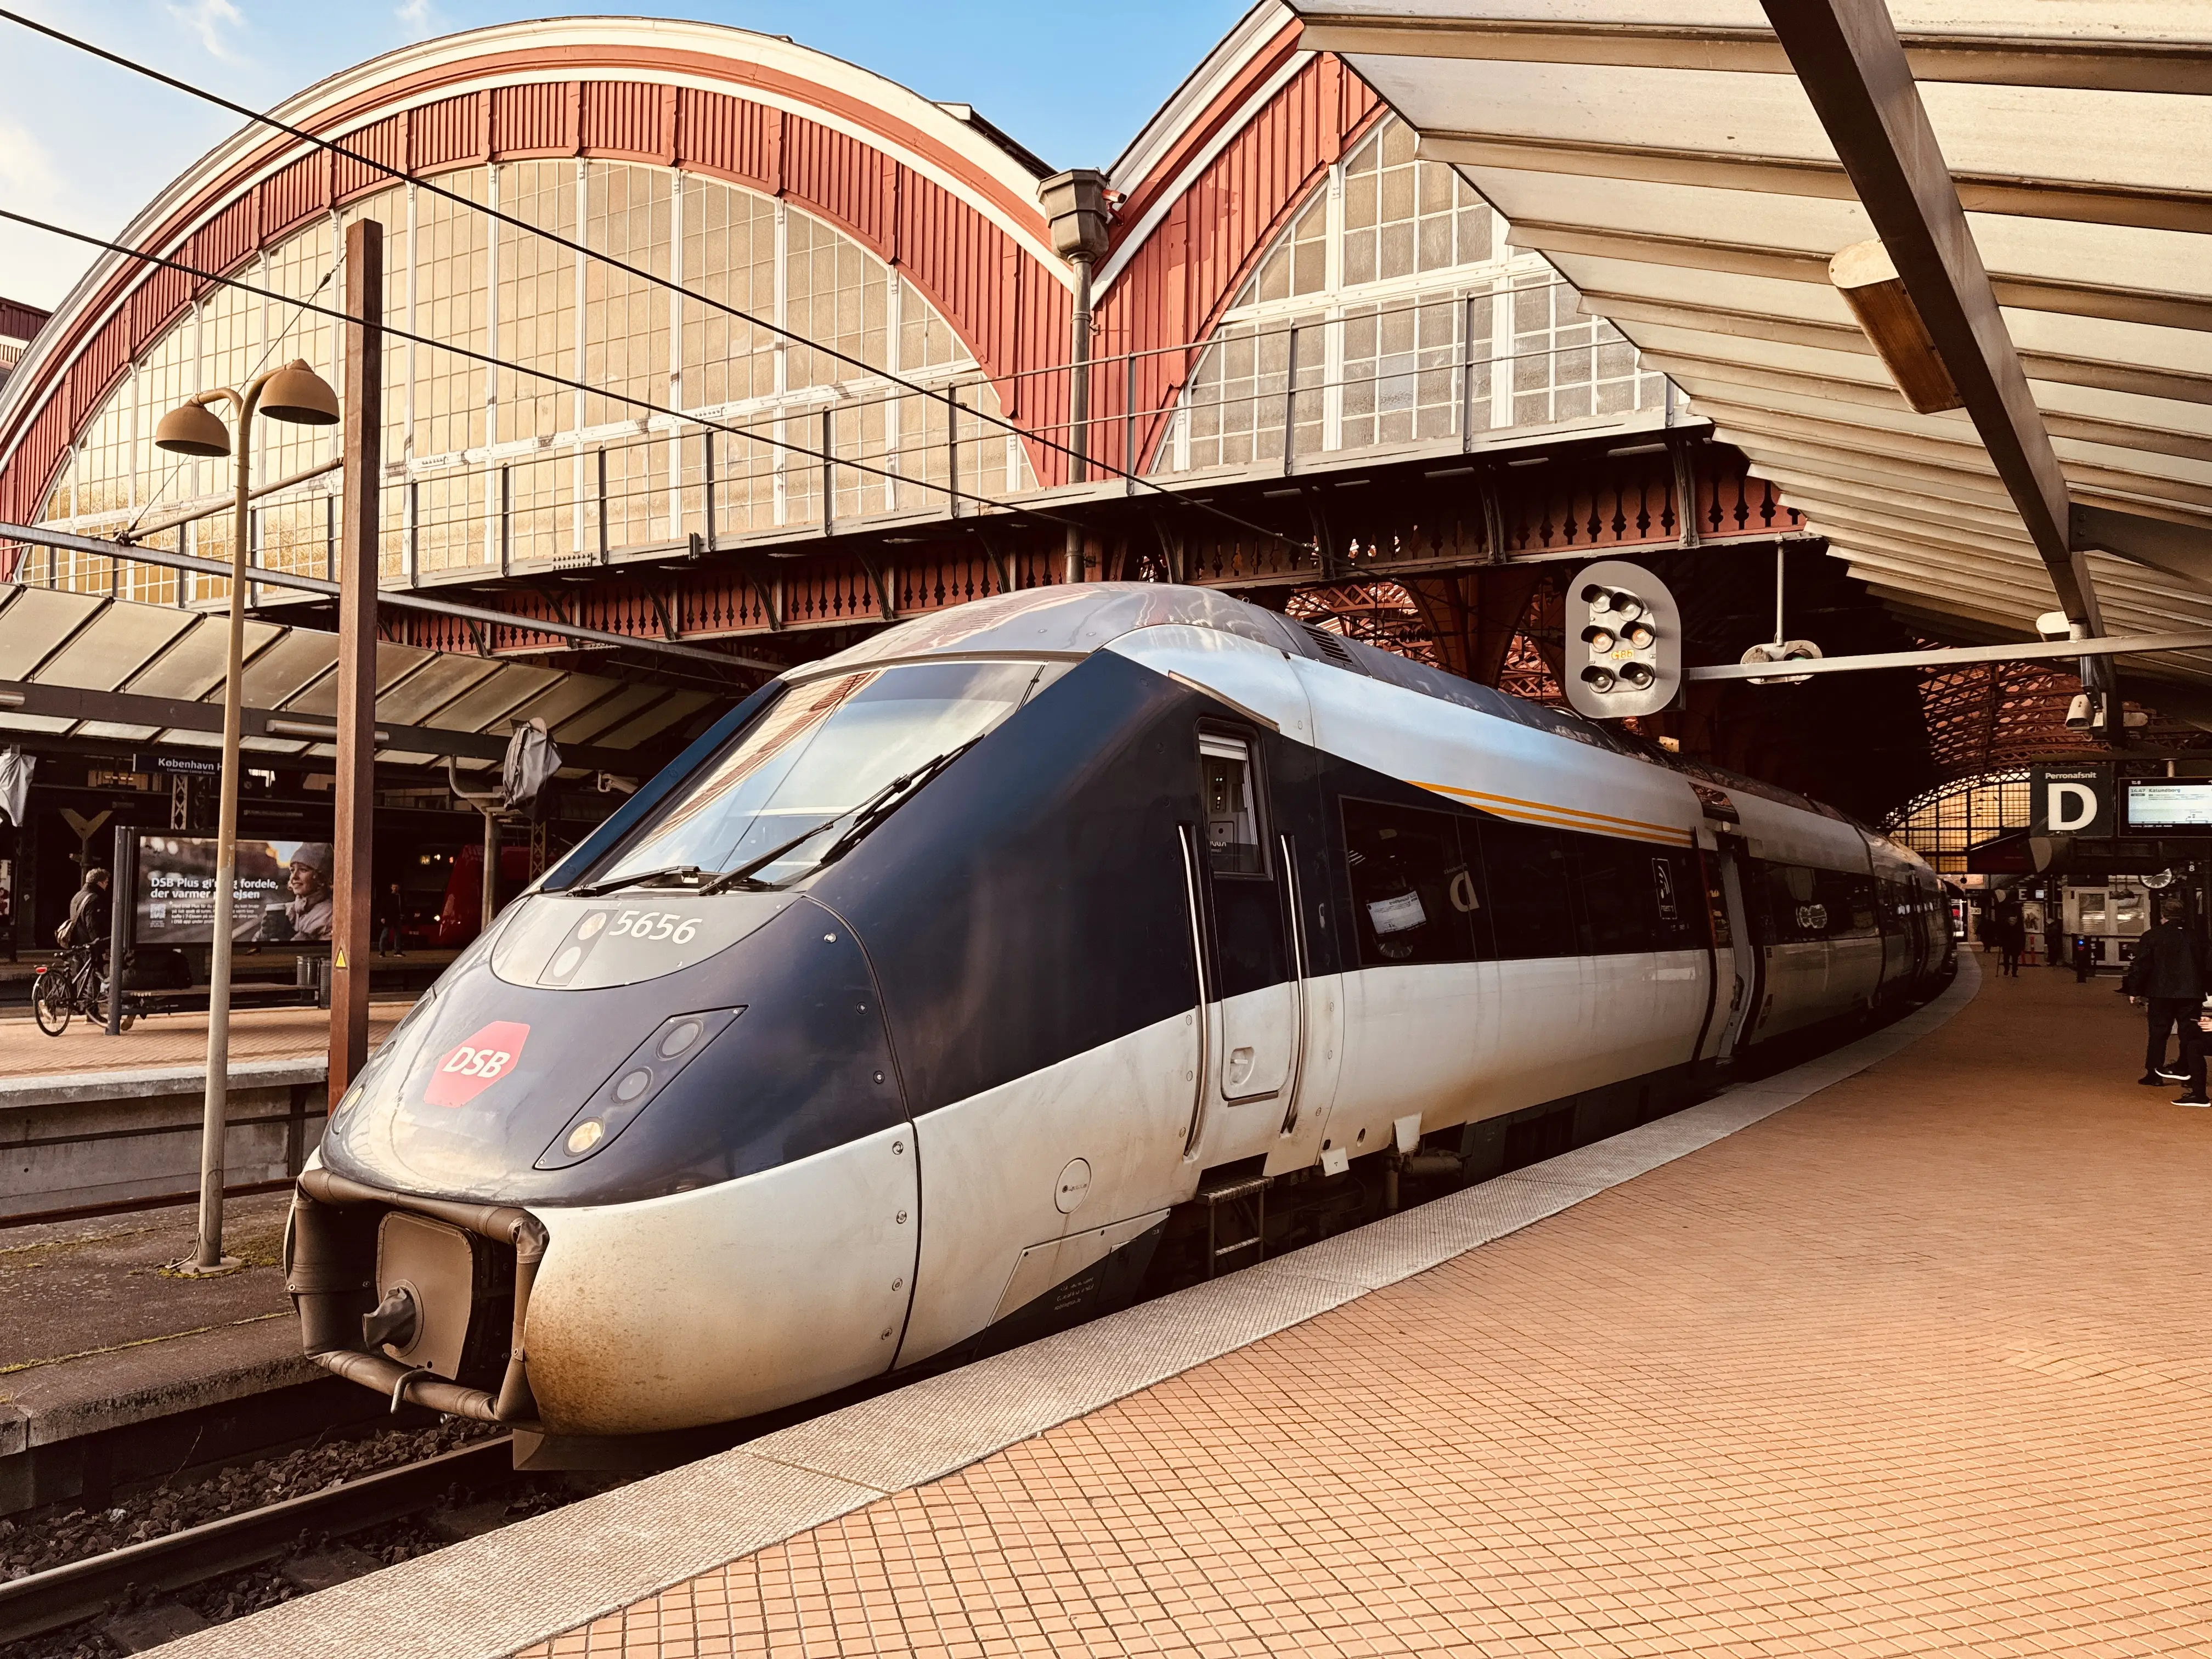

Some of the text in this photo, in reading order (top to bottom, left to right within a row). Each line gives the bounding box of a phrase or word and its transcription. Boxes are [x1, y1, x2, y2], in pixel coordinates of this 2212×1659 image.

[1611, 650, 1633, 660] G8b
[158, 758, 214, 770] København
[2048, 783, 2097, 830] D
[151, 878, 174, 887] DSB
[177, 878, 199, 888] Plus
[240, 878, 279, 890] fordele,
[150, 889, 170, 899] der
[172, 890, 211, 899] varmer
[233, 890, 260, 901] ejsen
[2019, 889, 2028, 900] E
[608, 910, 703, 944] 5656
[442, 1047, 511, 1078] DSB
